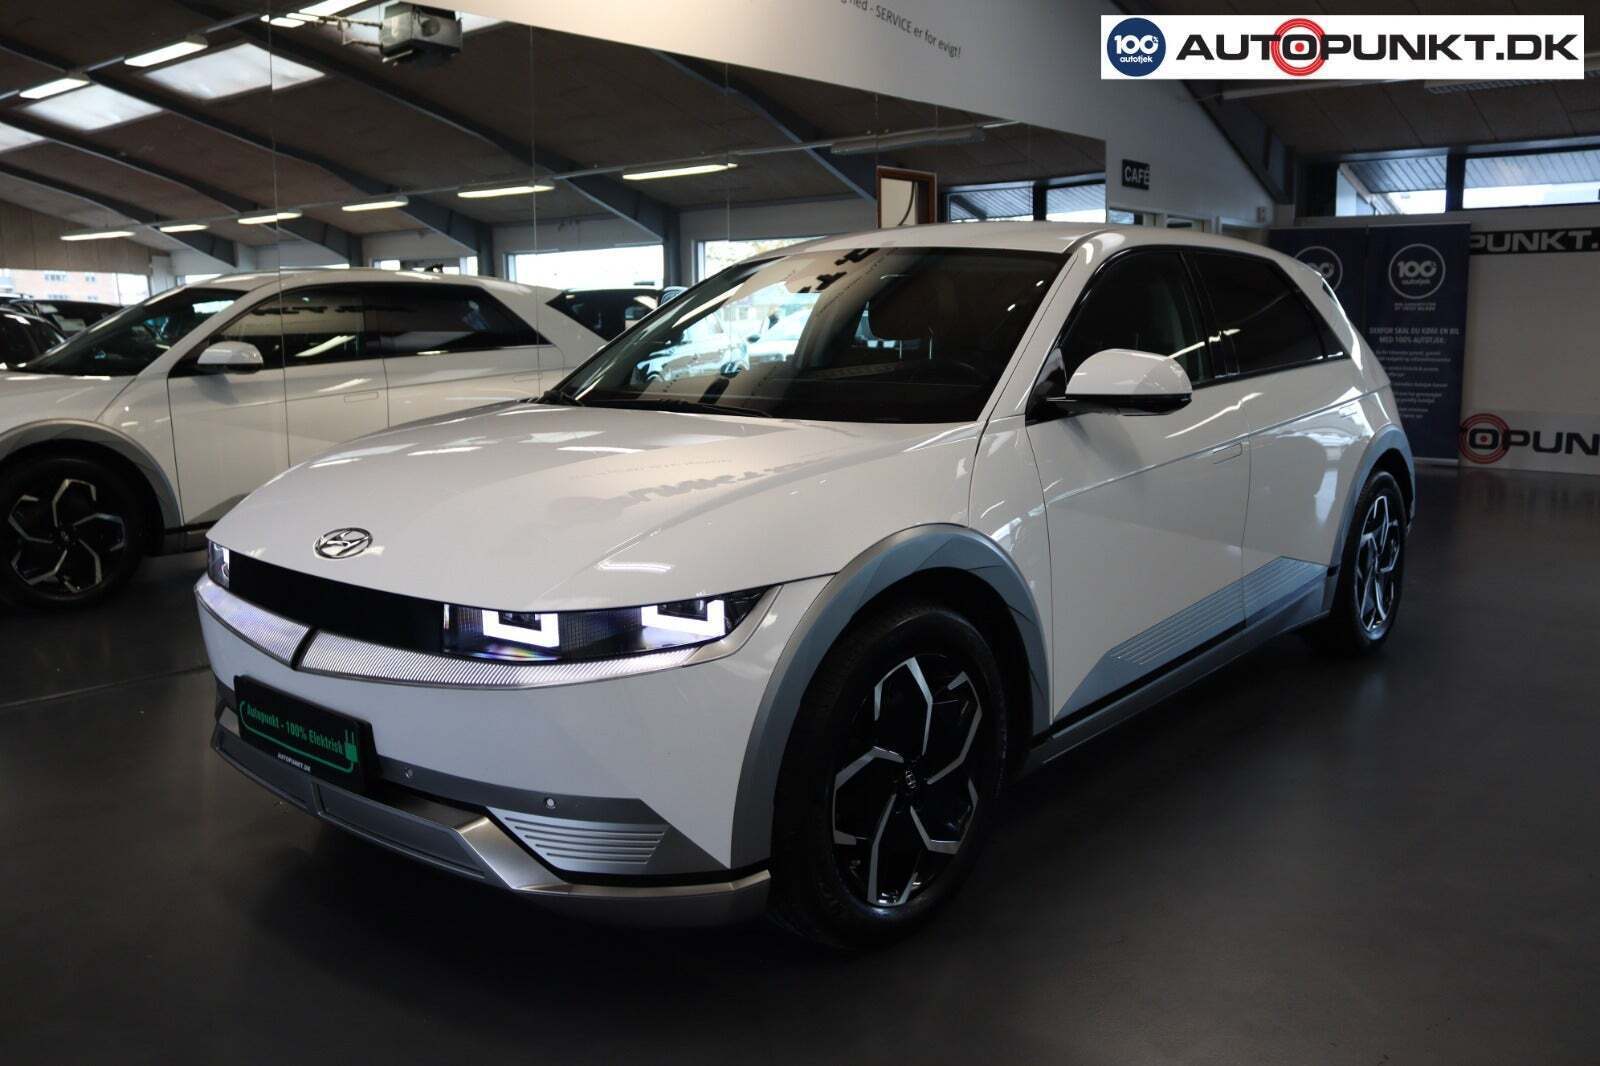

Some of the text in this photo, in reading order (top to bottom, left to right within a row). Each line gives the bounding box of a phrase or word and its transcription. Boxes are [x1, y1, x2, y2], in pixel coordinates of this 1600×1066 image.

[876, 5, 912, 33] SERVICE
[913, 27, 923, 38] er
[924, 29, 937, 46] for
[938, 39, 961, 58] evigt!
[1379, 336, 1394, 344] MED
[1395, 326, 1409, 335] SKAL
[1410, 326, 1420, 335] DU
[1439, 327, 1449, 336] EN
[1461, 428, 1600, 456] OPUN
[247, 703, 279, 729] Autopunkt
[286, 720, 308, 741] 100%
[278, 752, 311, 772] AUTOPUNKT.DK
